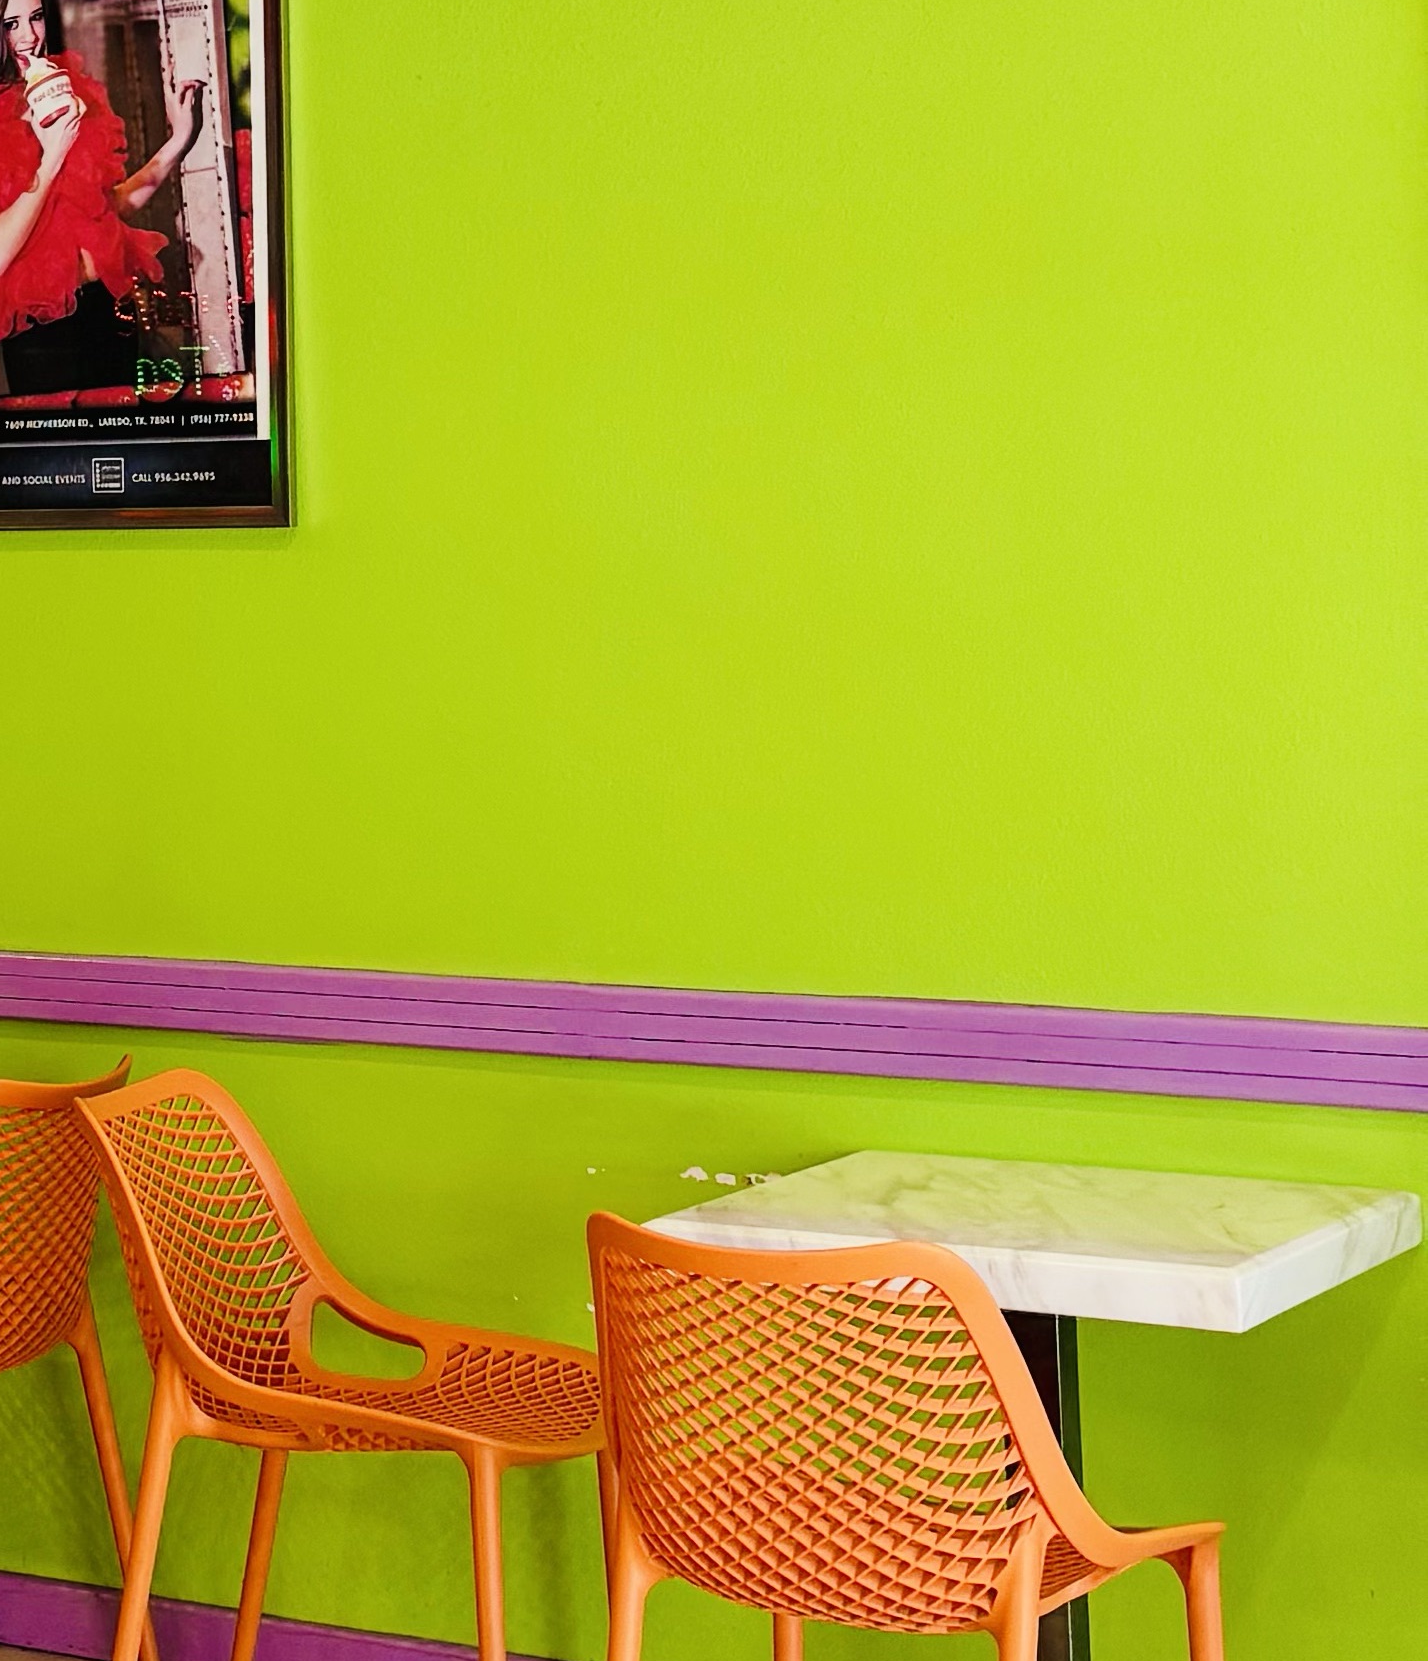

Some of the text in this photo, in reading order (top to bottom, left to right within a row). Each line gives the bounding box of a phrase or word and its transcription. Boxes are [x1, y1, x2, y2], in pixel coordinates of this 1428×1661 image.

[2, 476, 22, 486] AND
[23, 475, 53, 486] SOCIAL
[55, 474, 86, 485] EVENTS
[131, 472, 153, 483] CALL
